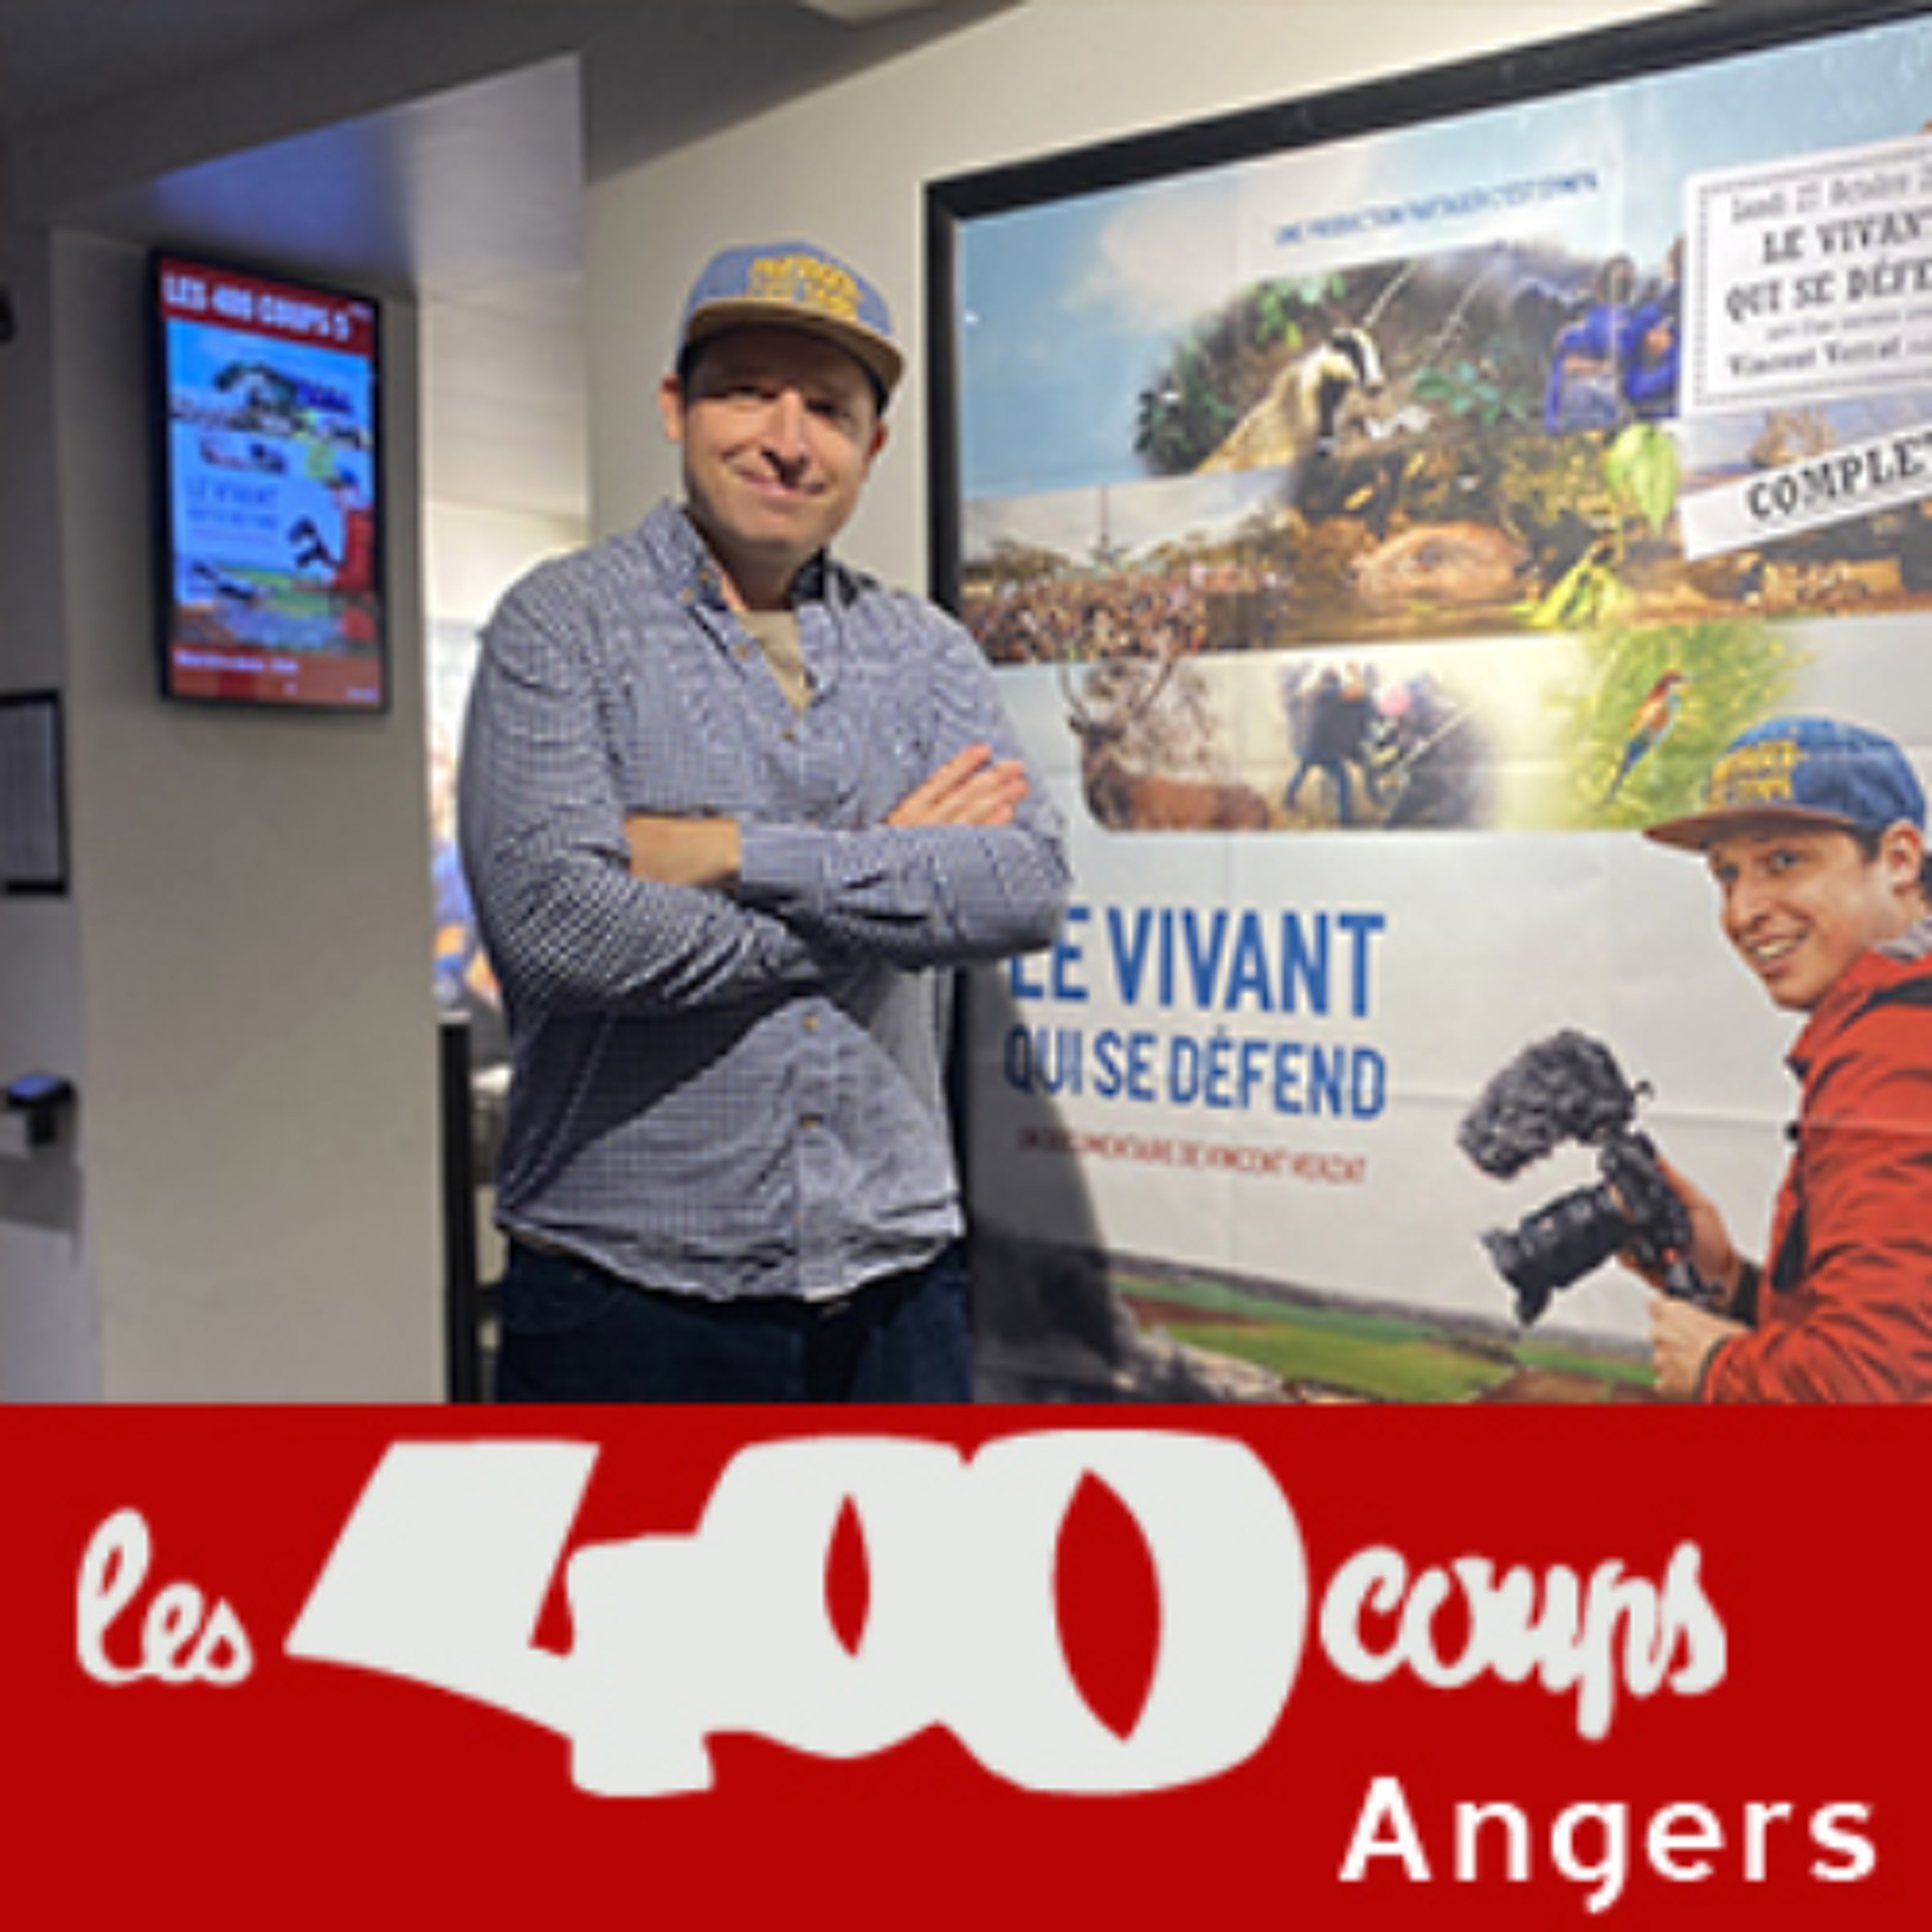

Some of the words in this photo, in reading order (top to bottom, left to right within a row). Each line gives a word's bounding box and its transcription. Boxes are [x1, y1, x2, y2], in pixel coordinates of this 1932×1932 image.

[1763, 225, 1804, 264] LE
[163, 273, 207, 310] LES
[1725, 279, 1780, 322] QUI
[1794, 269, 1835, 310] SE
[1106, 906, 1387, 1018] VIVANT
[1003, 1023, 1083, 1096] QUI
[1094, 1029, 1157, 1103] SE
[1170, 1023, 1387, 1121] DÉFEND
